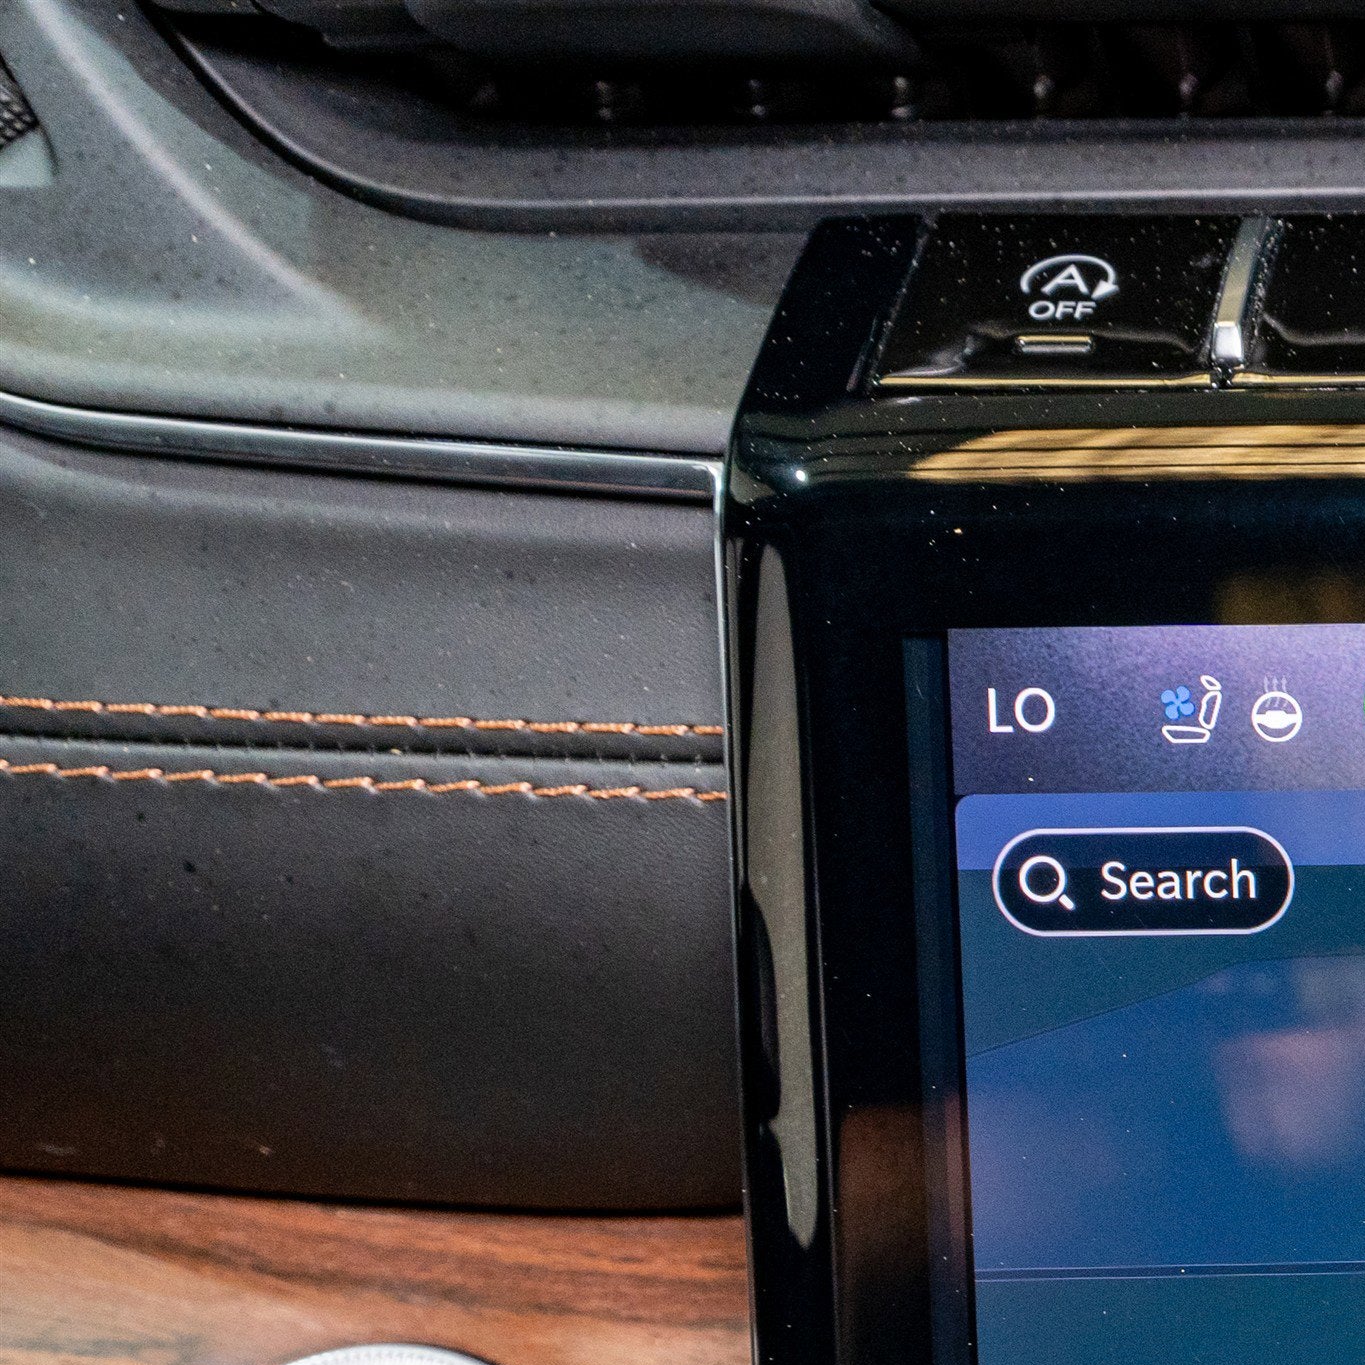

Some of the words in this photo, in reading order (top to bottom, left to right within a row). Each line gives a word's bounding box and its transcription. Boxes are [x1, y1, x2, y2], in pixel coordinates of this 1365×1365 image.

[1029, 301, 1096, 319] OFF
[988, 688, 1055, 732] LO
[1102, 858, 1255, 899] Search
